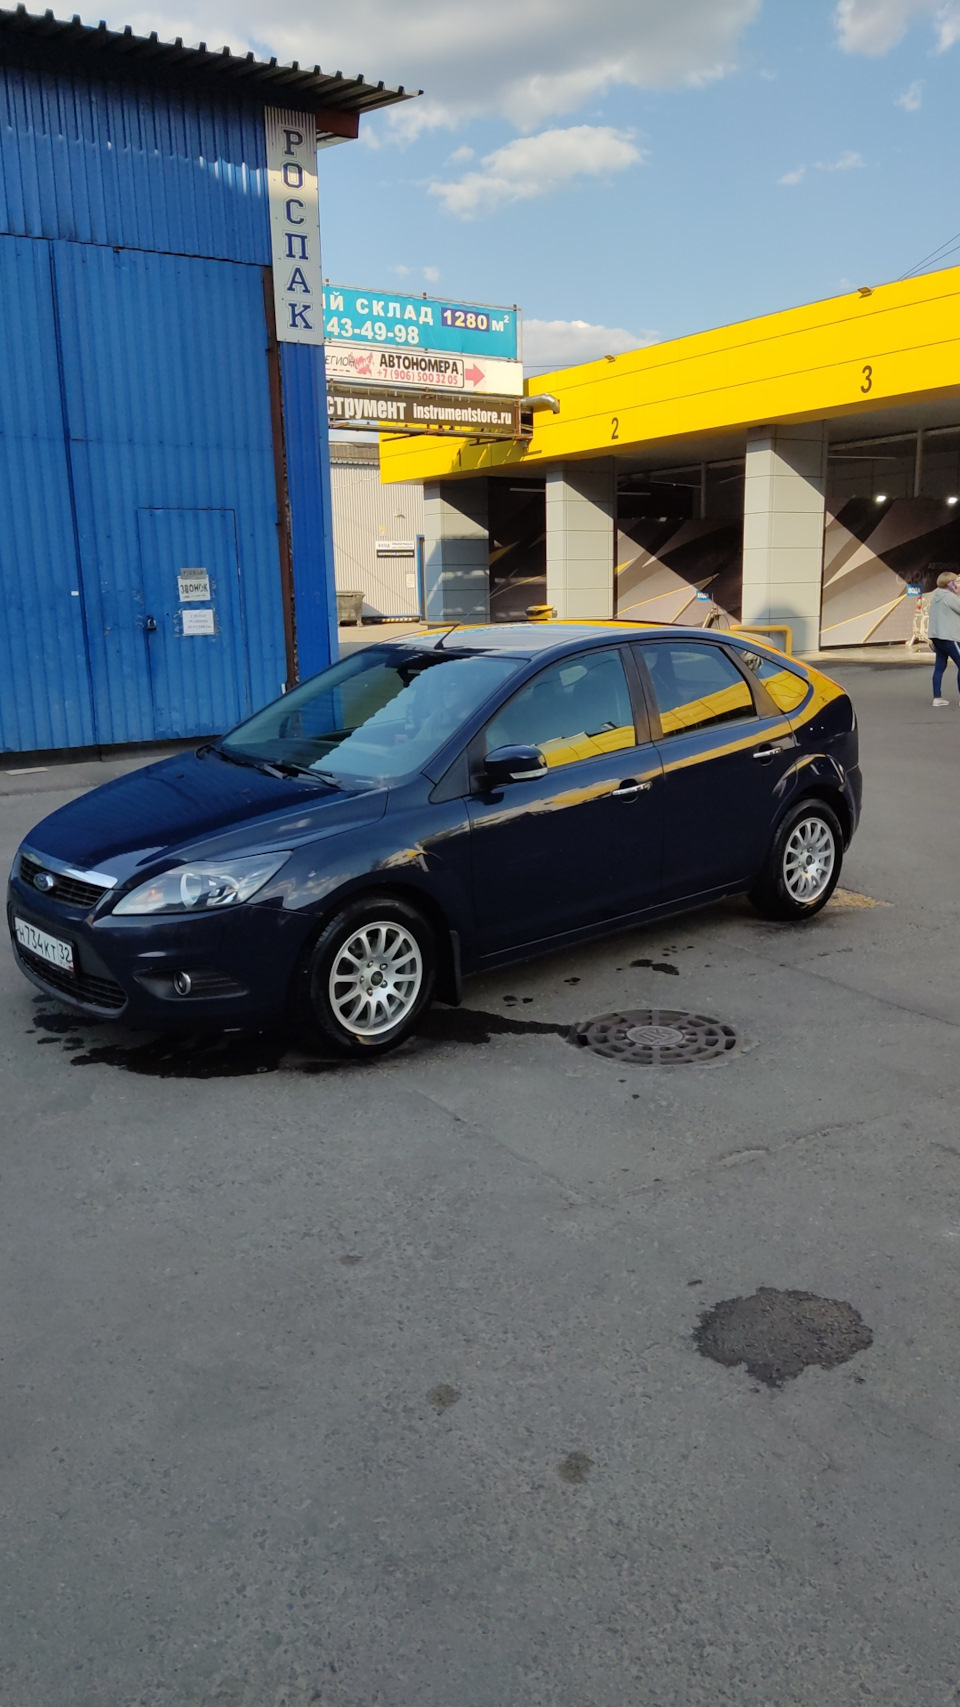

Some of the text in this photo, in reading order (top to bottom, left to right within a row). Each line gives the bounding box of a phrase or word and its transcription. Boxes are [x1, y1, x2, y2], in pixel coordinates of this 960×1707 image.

[282, 128, 314, 331] РОСПАК
[322, 290, 344, 312] Й
[355, 297, 434, 327] СКЛАД
[443, 310, 488, 330] 1280
[323, 314, 421, 345] 43-49-98
[379, 353, 459, 375] АВТОНОМЕРА
[377, 368, 458, 385] +7 (906) 500 32 05
[860, 364, 873, 394] 3
[412, 402, 512, 425] instrumentstore.ru
[611, 416, 620, 440] 2
[180, 582, 209, 594] ЗВОНОК
[58, 943, 73, 964] 32
